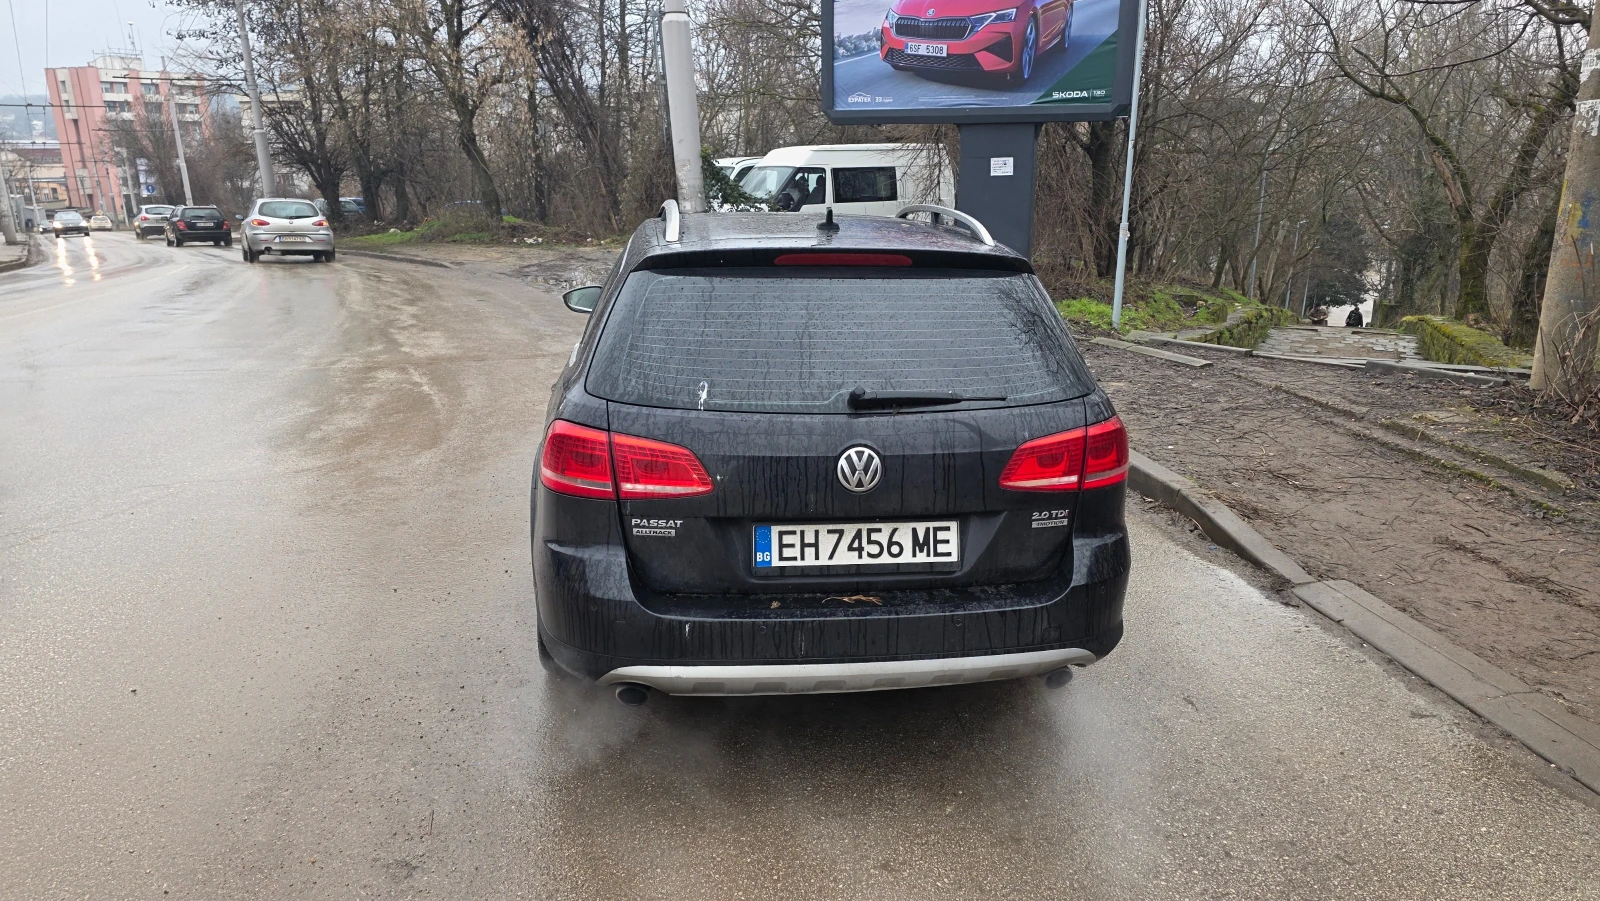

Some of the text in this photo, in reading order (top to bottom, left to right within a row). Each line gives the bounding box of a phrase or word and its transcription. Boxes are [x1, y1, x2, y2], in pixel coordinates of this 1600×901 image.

[909, 43, 944, 55] 6SF 5308
[1051, 509, 1069, 518] TDI
[631, 518, 684, 528] PASSAT
[756, 525, 953, 562] BG EH 7456 ME
